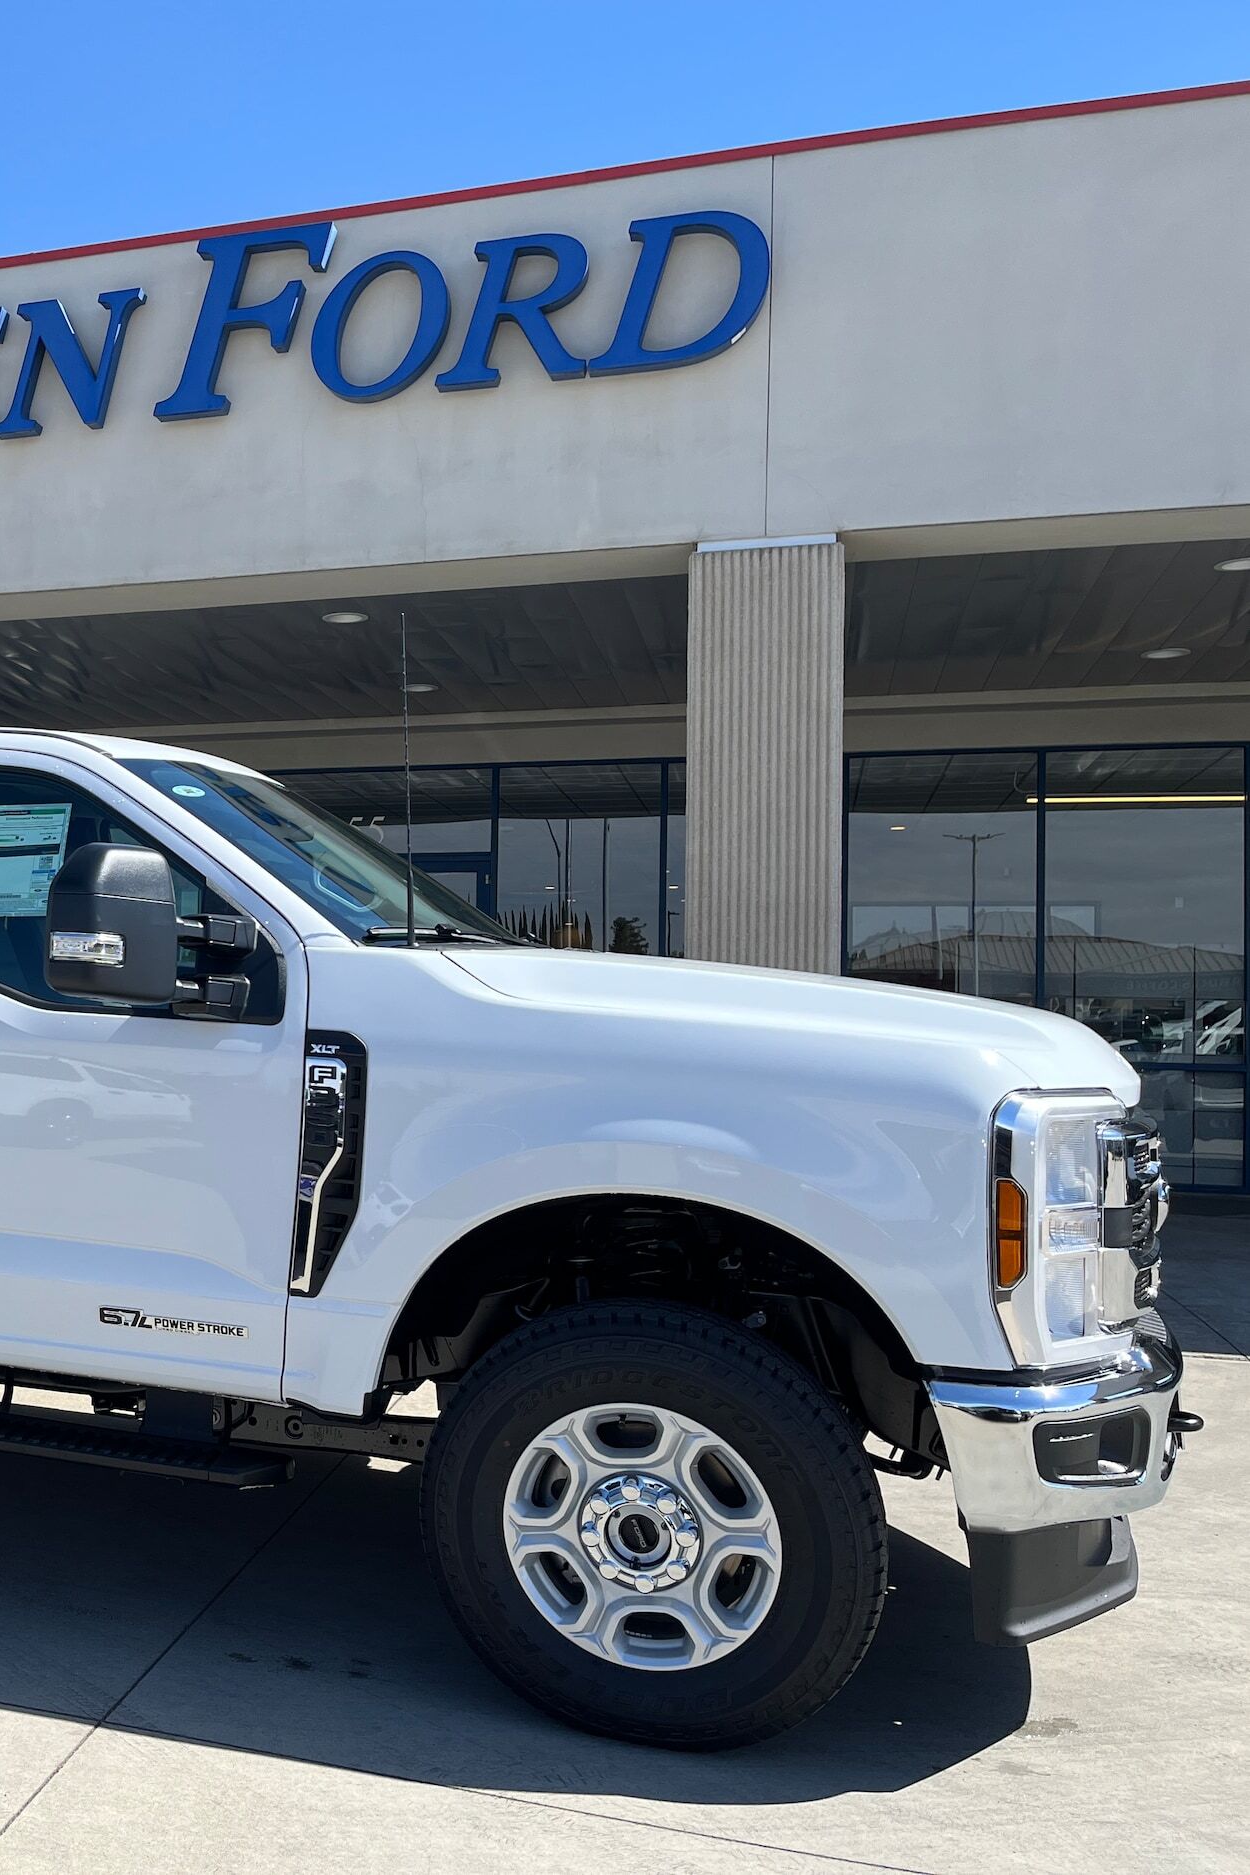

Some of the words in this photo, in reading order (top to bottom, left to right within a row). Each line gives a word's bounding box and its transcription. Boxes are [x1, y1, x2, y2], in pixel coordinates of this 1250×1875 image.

[153, 210, 772, 422] FORD
[310, 1043, 340, 1054] XLT
[100, 1307, 152, 1329] 6.7L
[154, 1317, 194, 1331] POWER
[198, 1322, 244, 1337] STROKE
